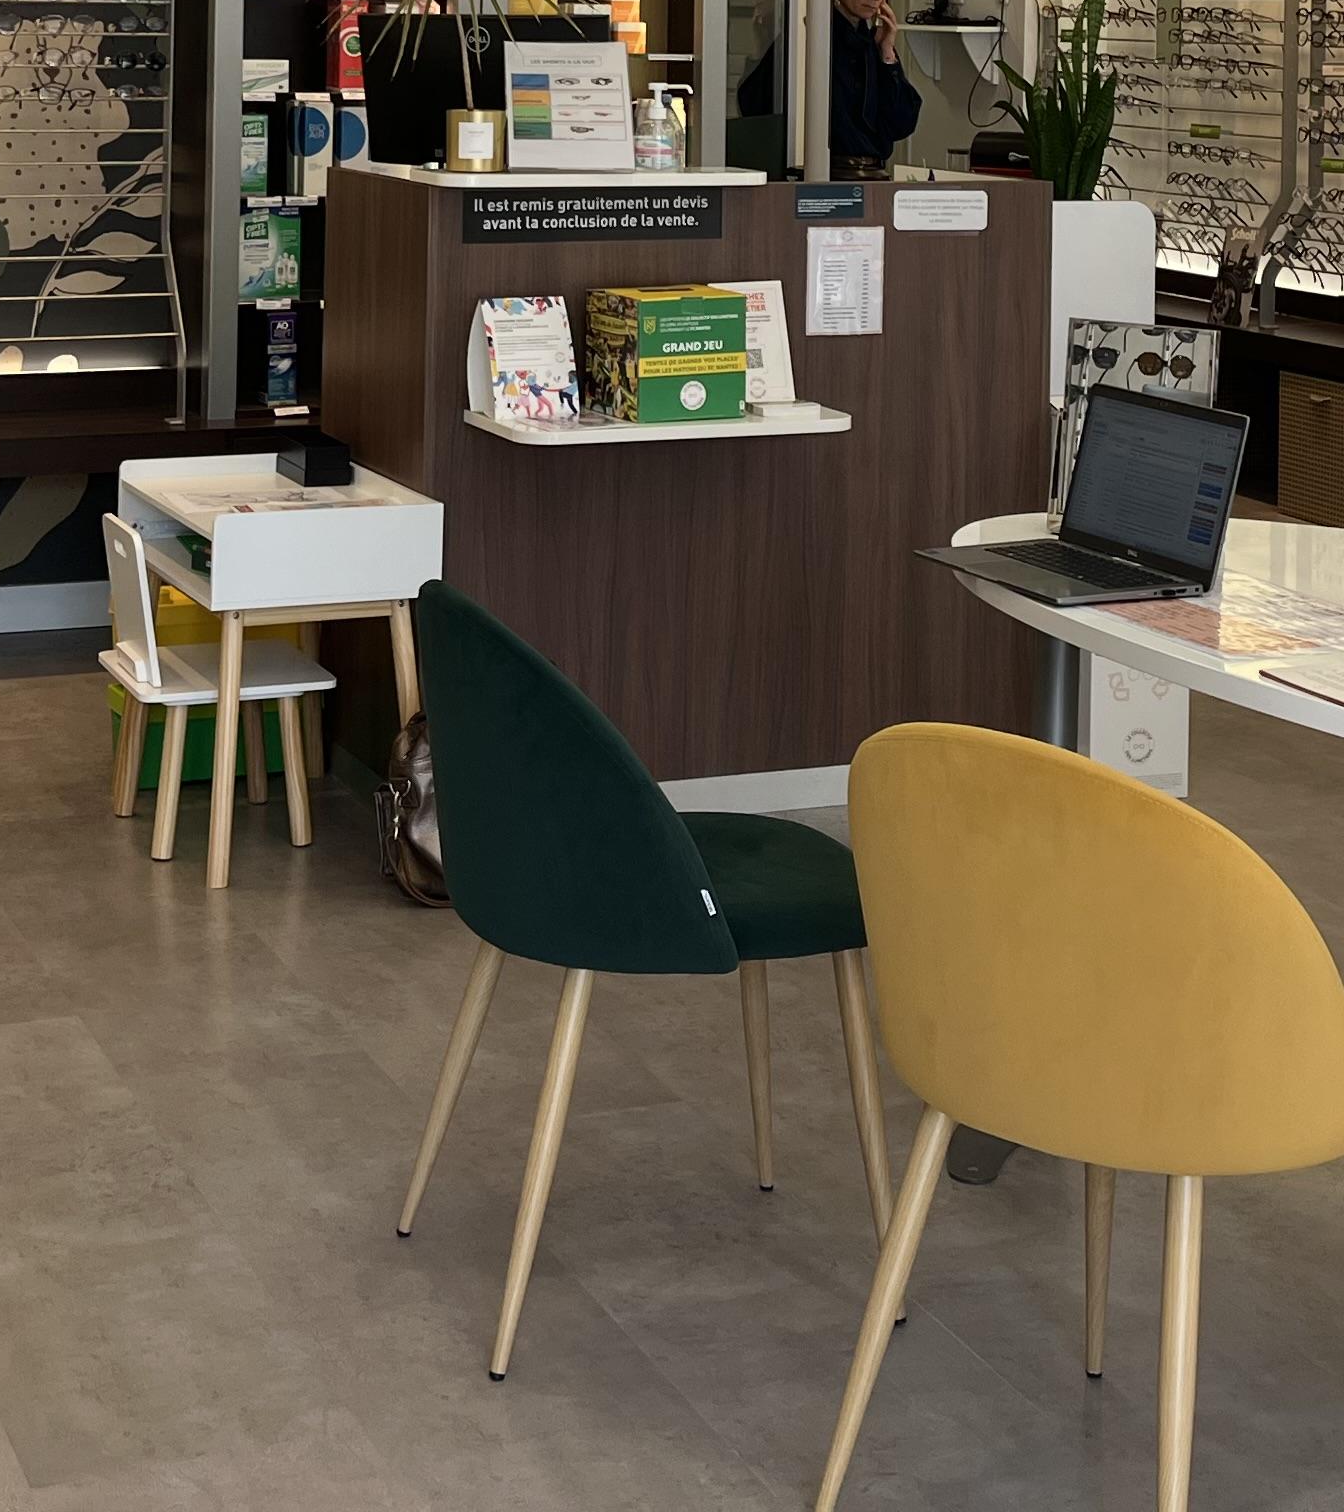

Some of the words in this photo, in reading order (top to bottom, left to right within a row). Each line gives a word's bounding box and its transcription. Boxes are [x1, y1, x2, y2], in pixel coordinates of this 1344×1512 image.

[473, 198, 484, 212] Il
[487, 199, 510, 212] est
[513, 197, 554, 211] remis
[557, 196, 649, 214] gratuitement
[652, 197, 670, 210] un
[673, 195, 709, 209] devis
[482, 217, 522, 230] avant
[525, 216, 539, 229] la
[542, 214, 617, 229] conclusion
[620, 214, 637, 227] de
[641, 213, 654, 227] la
[657, 214, 699, 227] vente.
[662, 341, 702, 353] GRAND
[703, 340, 723, 351] JEU
